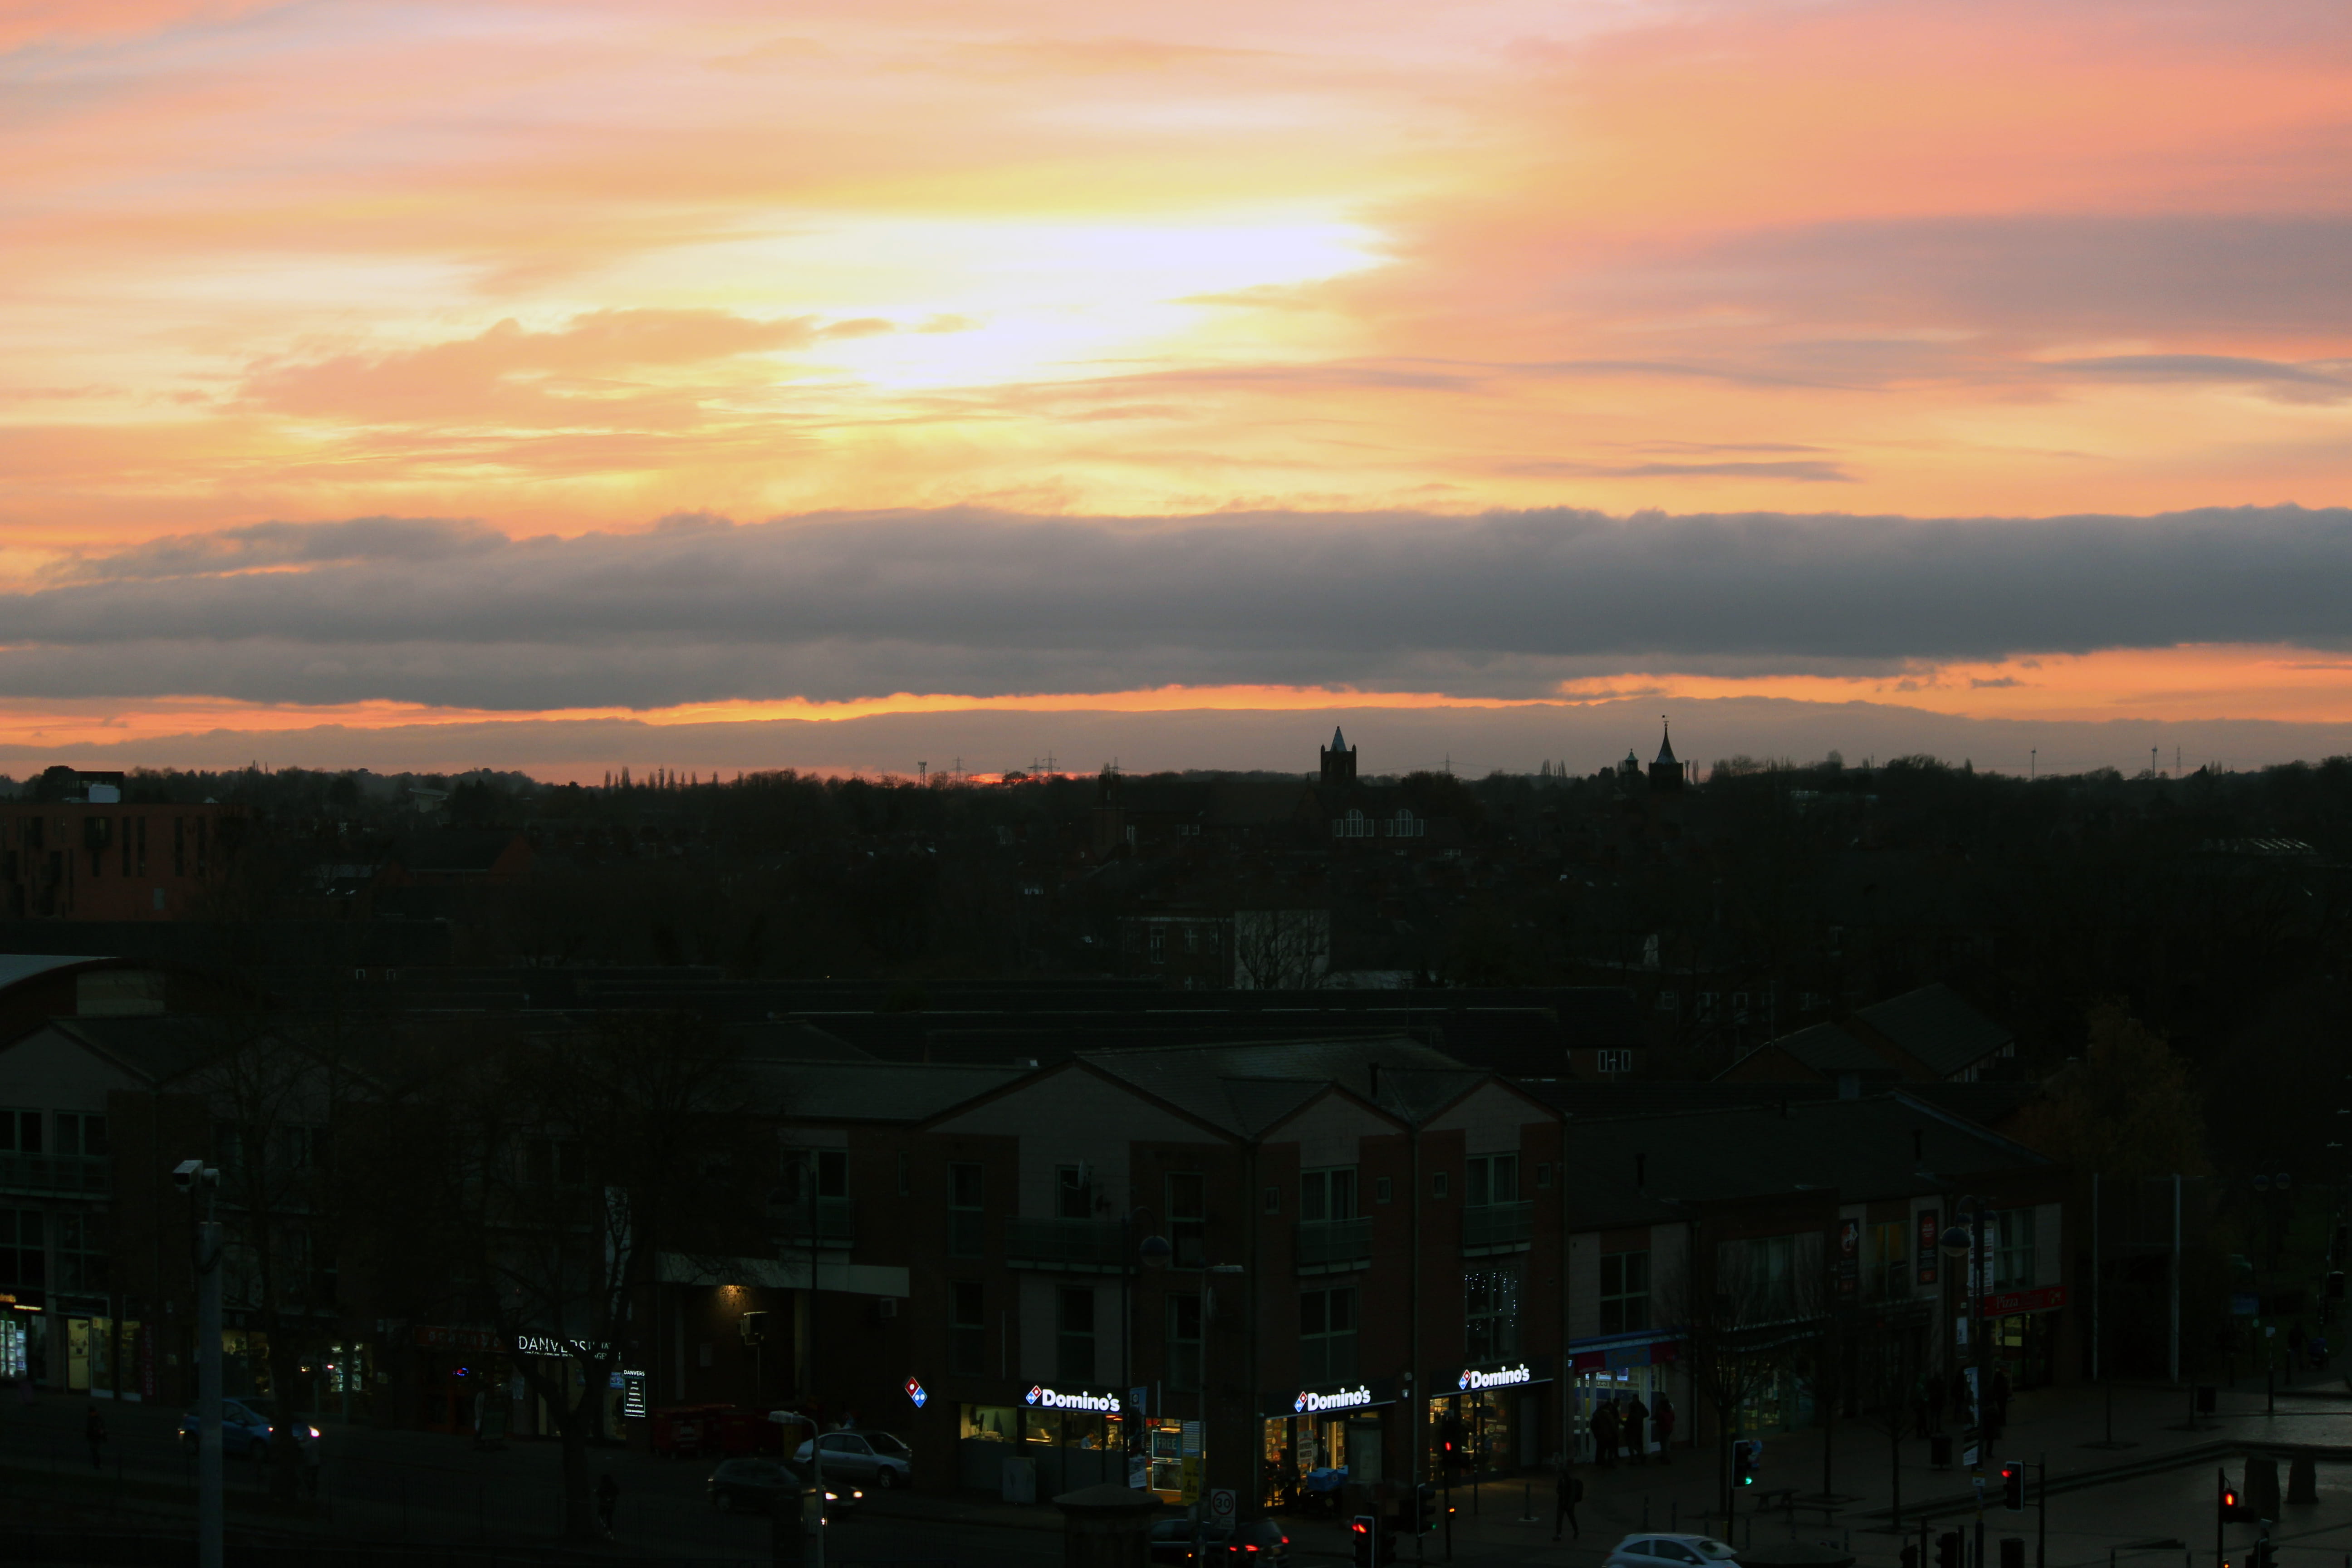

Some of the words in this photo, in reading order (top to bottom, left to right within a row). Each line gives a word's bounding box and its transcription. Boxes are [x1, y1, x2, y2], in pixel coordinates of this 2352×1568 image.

[1996, 1296, 2019, 1309] Pizza
[1471, 1363, 1530, 1389] Domino's
[1042, 1389, 1120, 1412] Domino's
[1308, 1385, 1371, 1411] Domino's
[1157, 1438, 1176, 1450] FREE
[1216, 1498, 1231, 1508] 30
